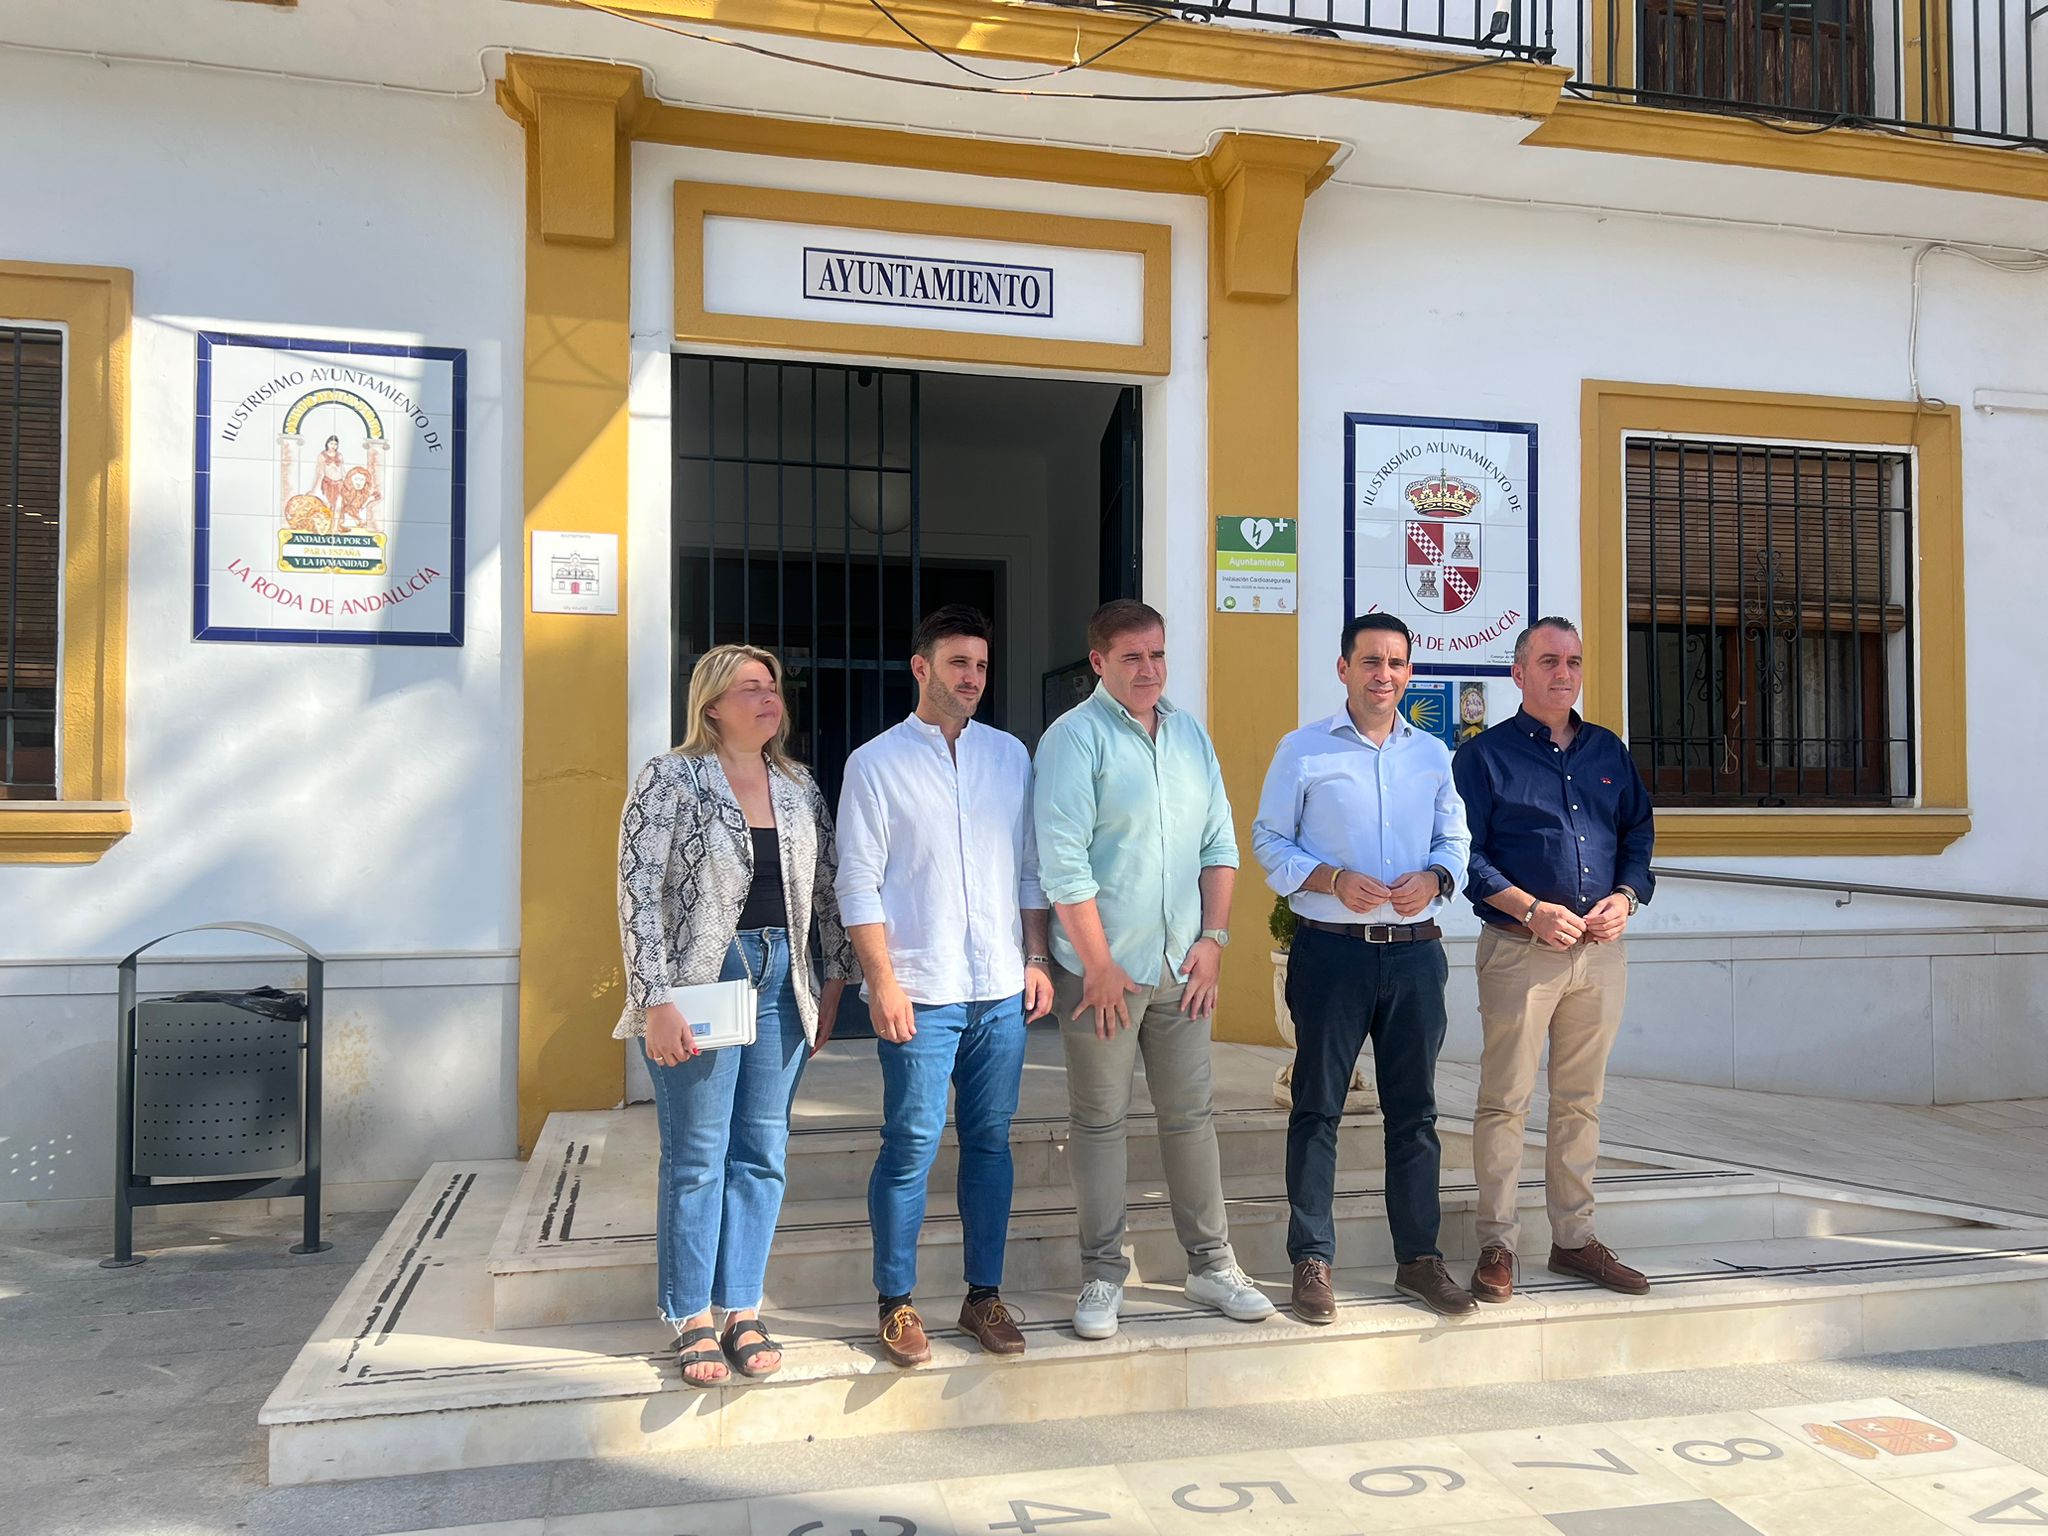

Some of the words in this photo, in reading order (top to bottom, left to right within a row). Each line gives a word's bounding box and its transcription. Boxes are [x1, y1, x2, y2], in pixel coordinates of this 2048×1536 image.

[818, 258, 1040, 309] AYUNTAMIENTO
[221, 371, 304, 442] ILUSTRISIMO
[310, 368, 428, 430] AYUNTAMIENTO
[423, 431, 443, 453] DE
[1362, 444, 1422, 506] ILUSTRISIMO
[1425, 441, 1512, 492] AYUNTAMIENTO
[1507, 493, 1522, 513] DE
[304, 547, 327, 556] PARA
[343, 537, 361, 545] POR
[294, 558, 301, 566] Y
[302, 558, 315, 566] LA
[1229, 556, 1285, 567] Ayuntamiento
[226, 558, 250, 584] LA
[250, 576, 303, 610] RODA
[310, 597, 335, 615] DE
[340, 567, 440, 615] ANDALUCÍA
[1426, 636, 1445, 651] DE
[1448, 608, 1521, 651] ANDALUCÍA
[1512, 1447, 1639, 1475] 7
[1672, 1437, 1784, 1467] 8
[1348, 1464, 1465, 1497] 6
[1172, 1481, 1299, 1513] 5
[988, 1499, 1112, 1534] 4
